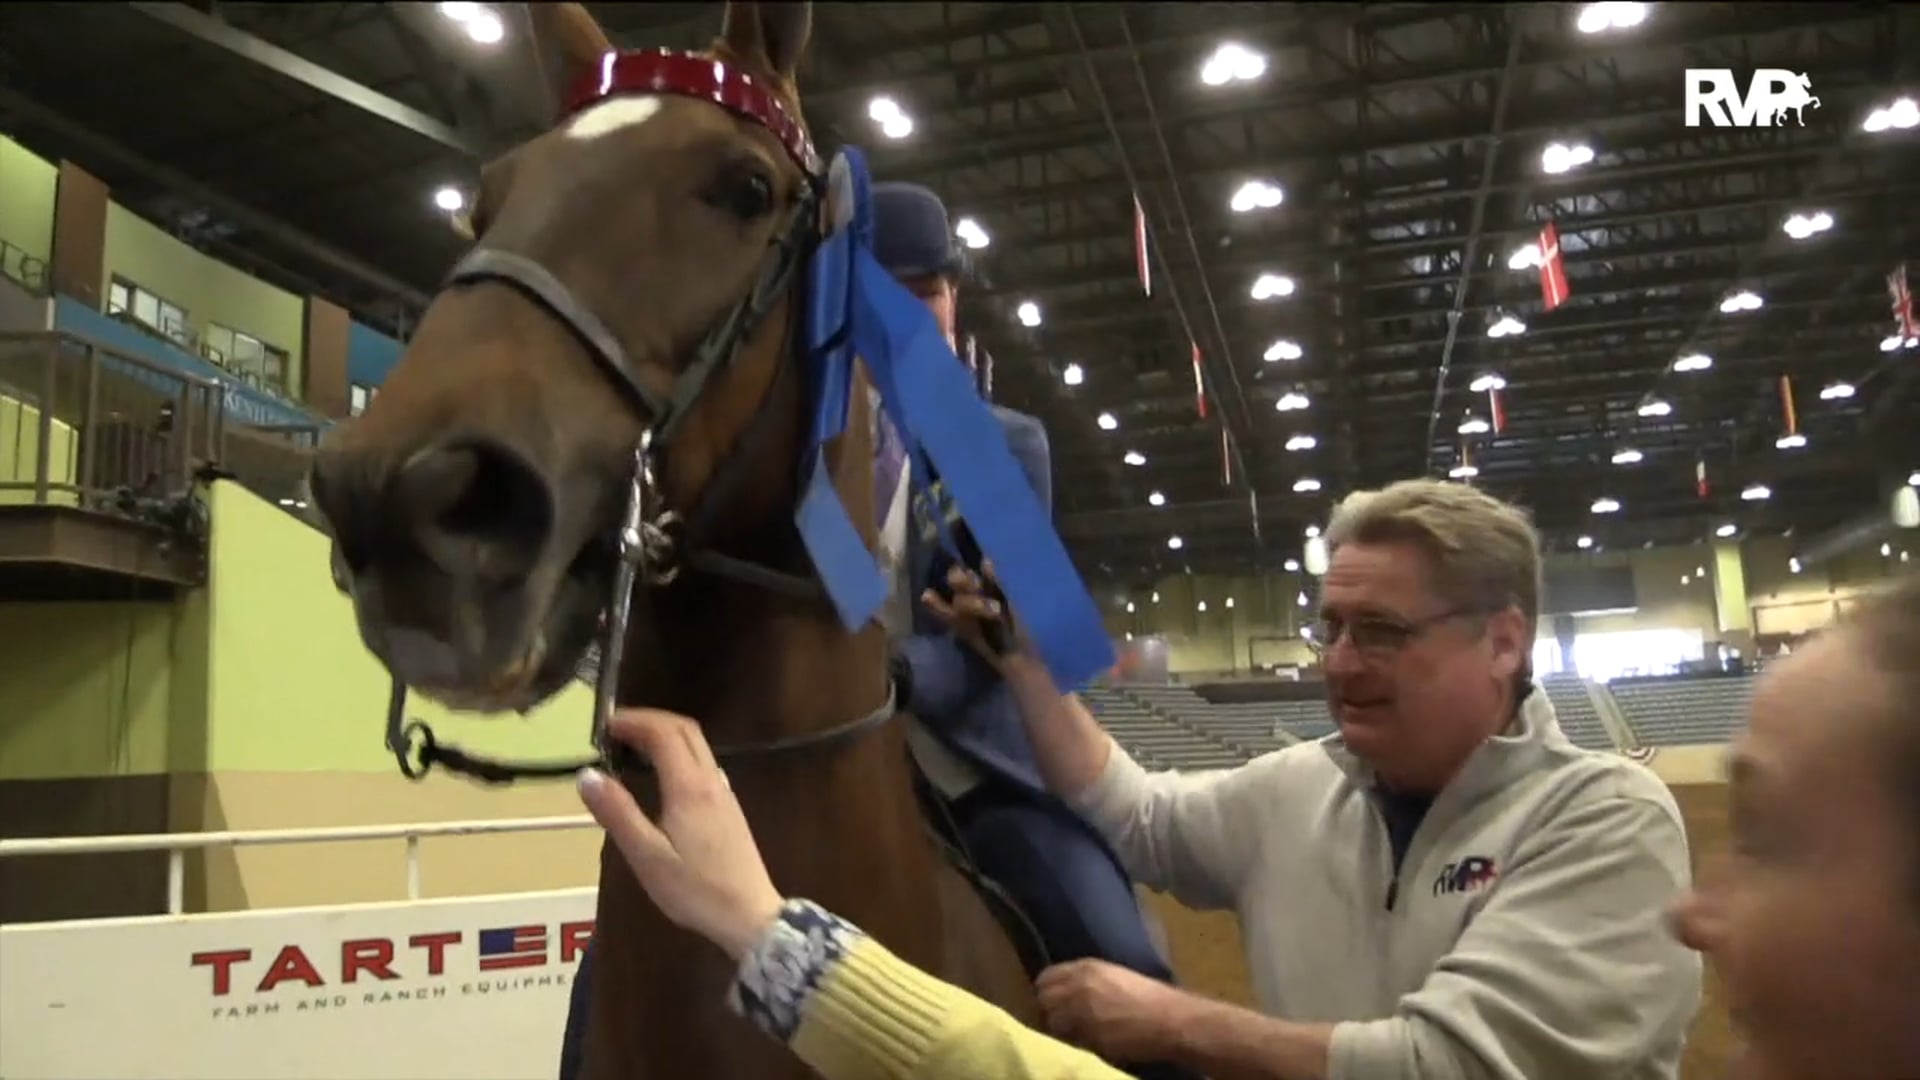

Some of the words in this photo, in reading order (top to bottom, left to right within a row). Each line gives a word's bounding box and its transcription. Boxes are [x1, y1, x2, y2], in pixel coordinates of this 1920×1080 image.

[212, 1003, 280, 1018] FARM
[297, 996, 347, 1010] AND
[363, 986, 447, 1004] RANCH
[461, 974, 569, 994] EQUIPME
